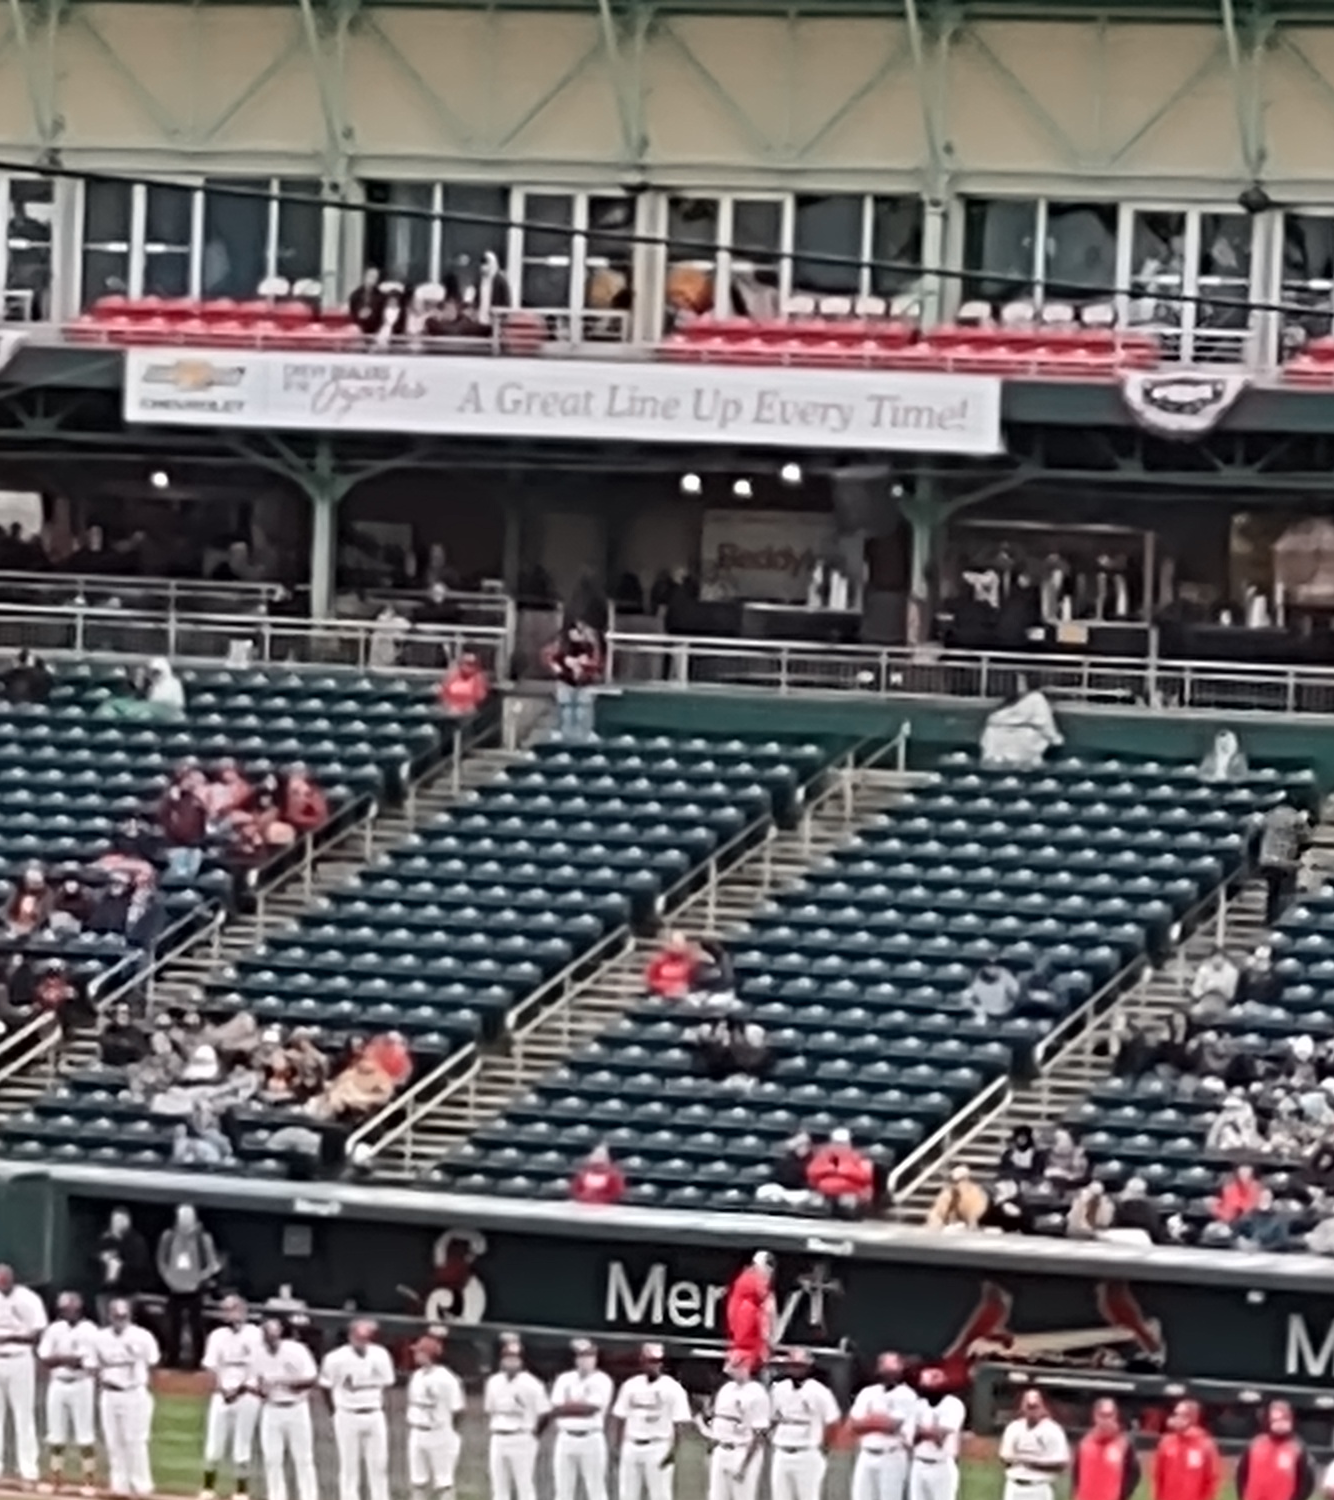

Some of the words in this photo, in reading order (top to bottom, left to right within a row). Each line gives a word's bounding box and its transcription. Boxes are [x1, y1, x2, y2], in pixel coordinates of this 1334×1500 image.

[456, 381, 485, 415] A
[495, 382, 594, 418] Great
[603, 384, 682, 421] Line
[692, 387, 743, 430] Up
[752, 389, 855, 433] Every
[867, 393, 969, 432] Time!
